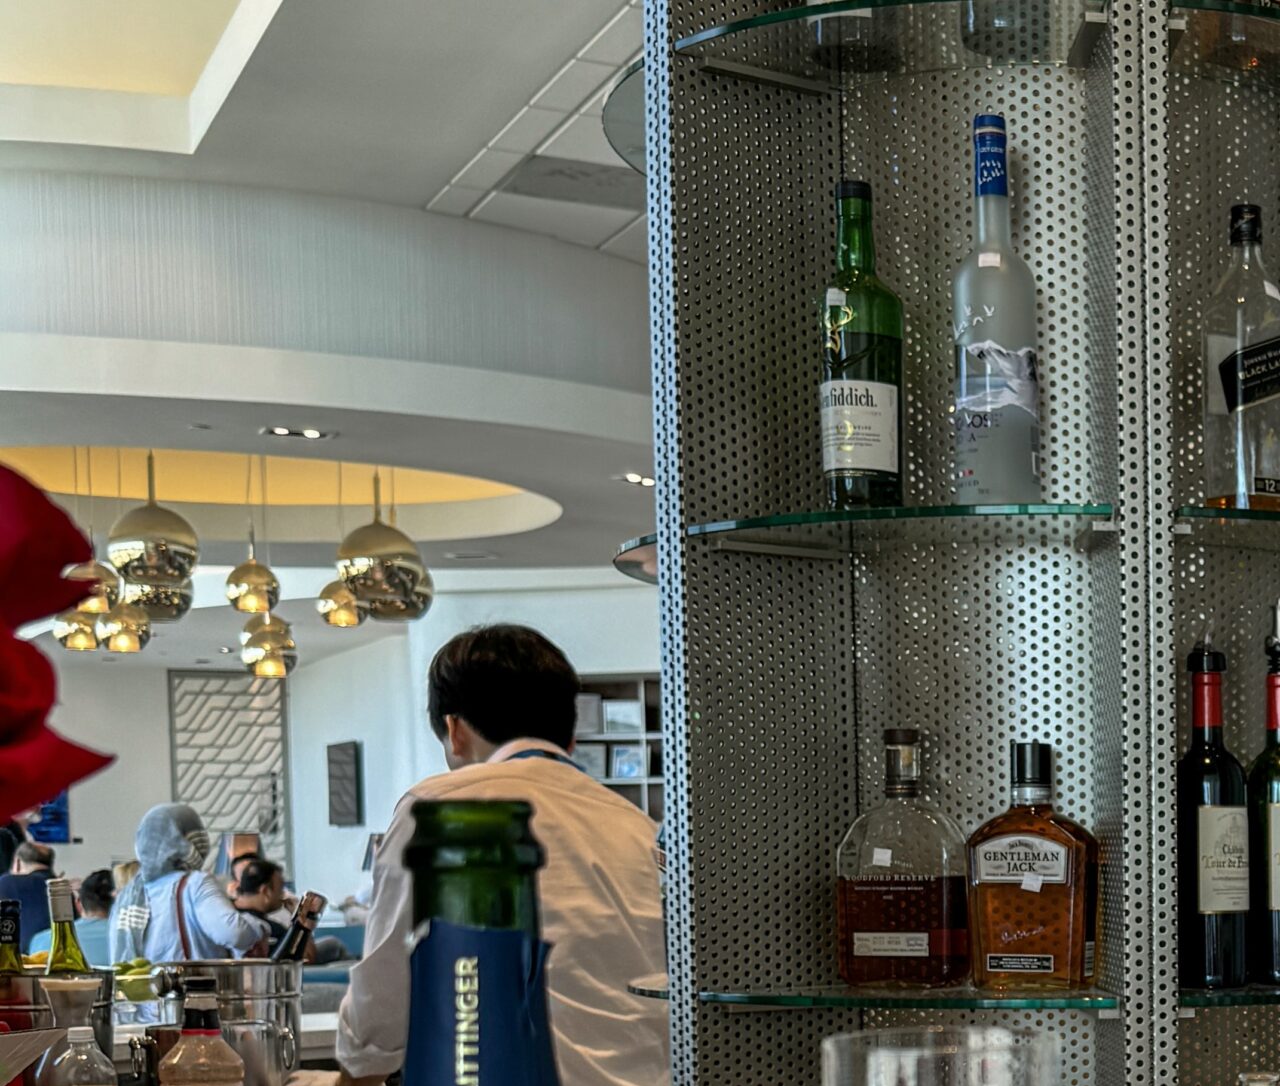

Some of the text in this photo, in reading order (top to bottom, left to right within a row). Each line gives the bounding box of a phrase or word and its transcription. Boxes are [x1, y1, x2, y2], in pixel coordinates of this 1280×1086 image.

[1265, 480, 1276, 492] 12
[983, 851, 1059, 862] GENTLEMAN
[1006, 863, 1037, 873] JACK
